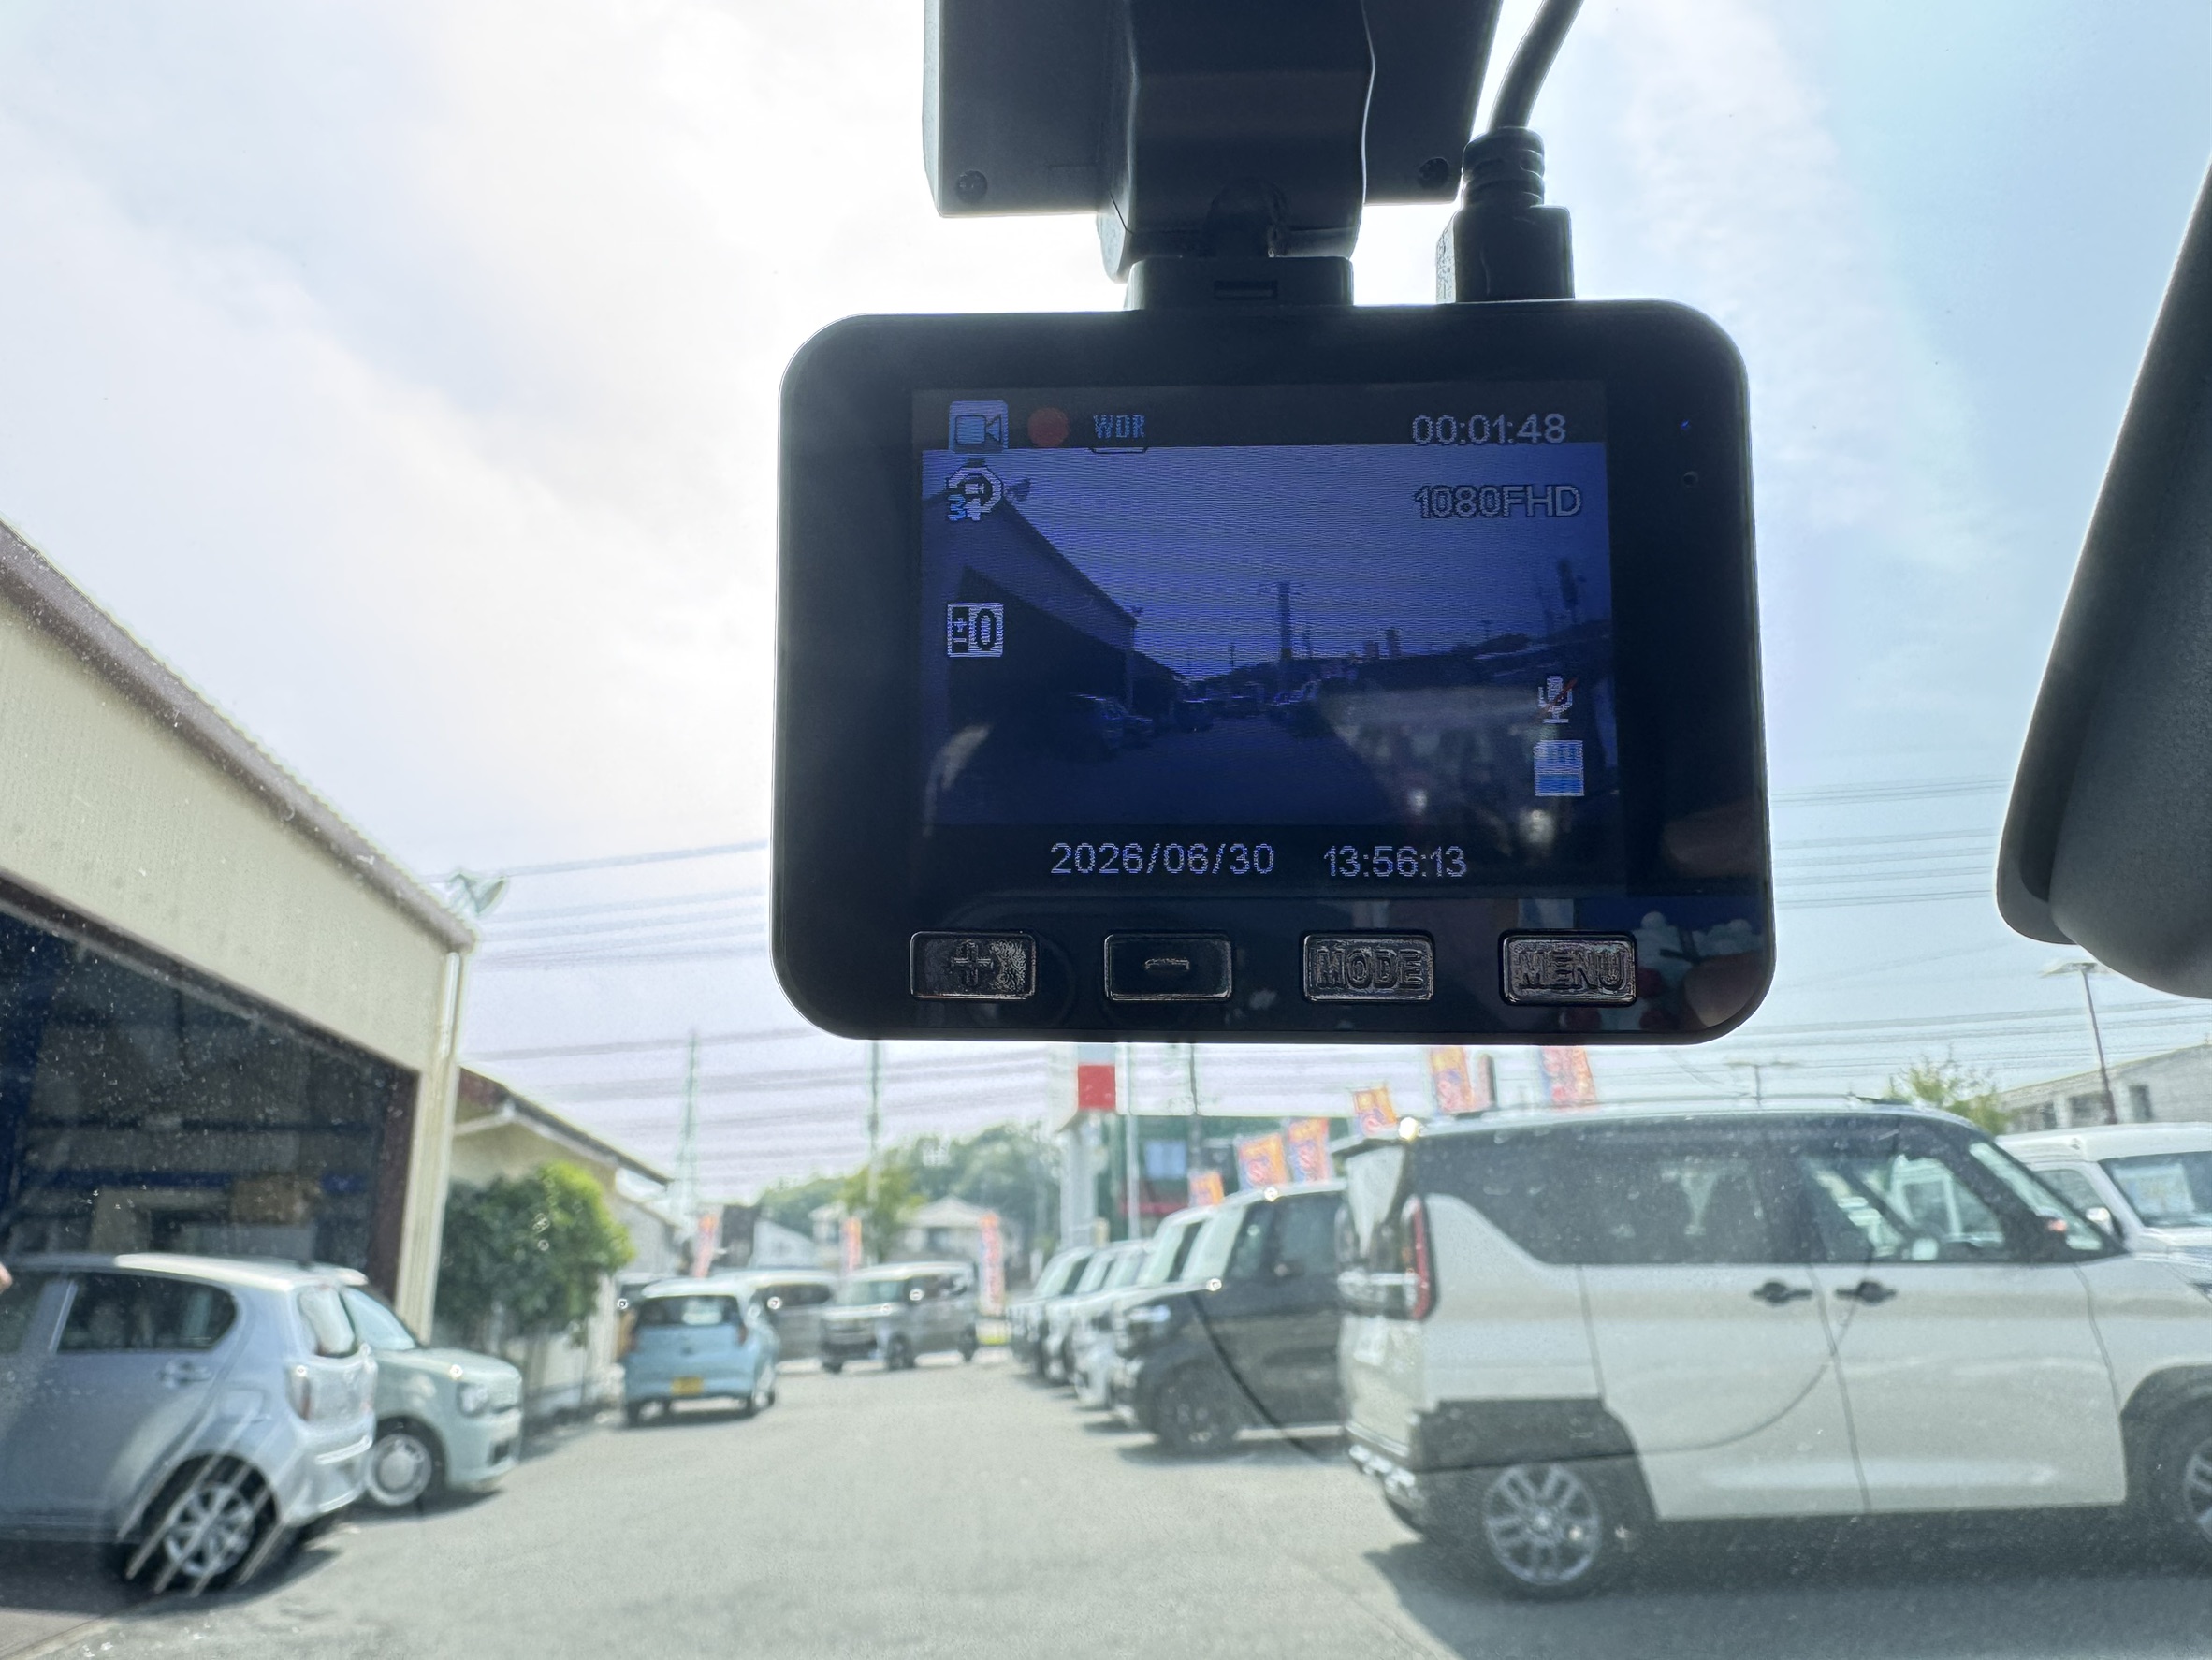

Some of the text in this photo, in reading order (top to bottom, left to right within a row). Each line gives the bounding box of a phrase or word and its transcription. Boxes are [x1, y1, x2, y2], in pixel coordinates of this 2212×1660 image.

[1092, 414, 1145, 439] WDR
[1411, 413, 1566, 445] 00:01:48
[1414, 484, 1583, 517] 1080FHD
[1049, 842, 1469, 878] 2026/06/30 13:56:13
[1315, 948, 1425, 990] MODE
[1515, 948, 1628, 992] MENU
